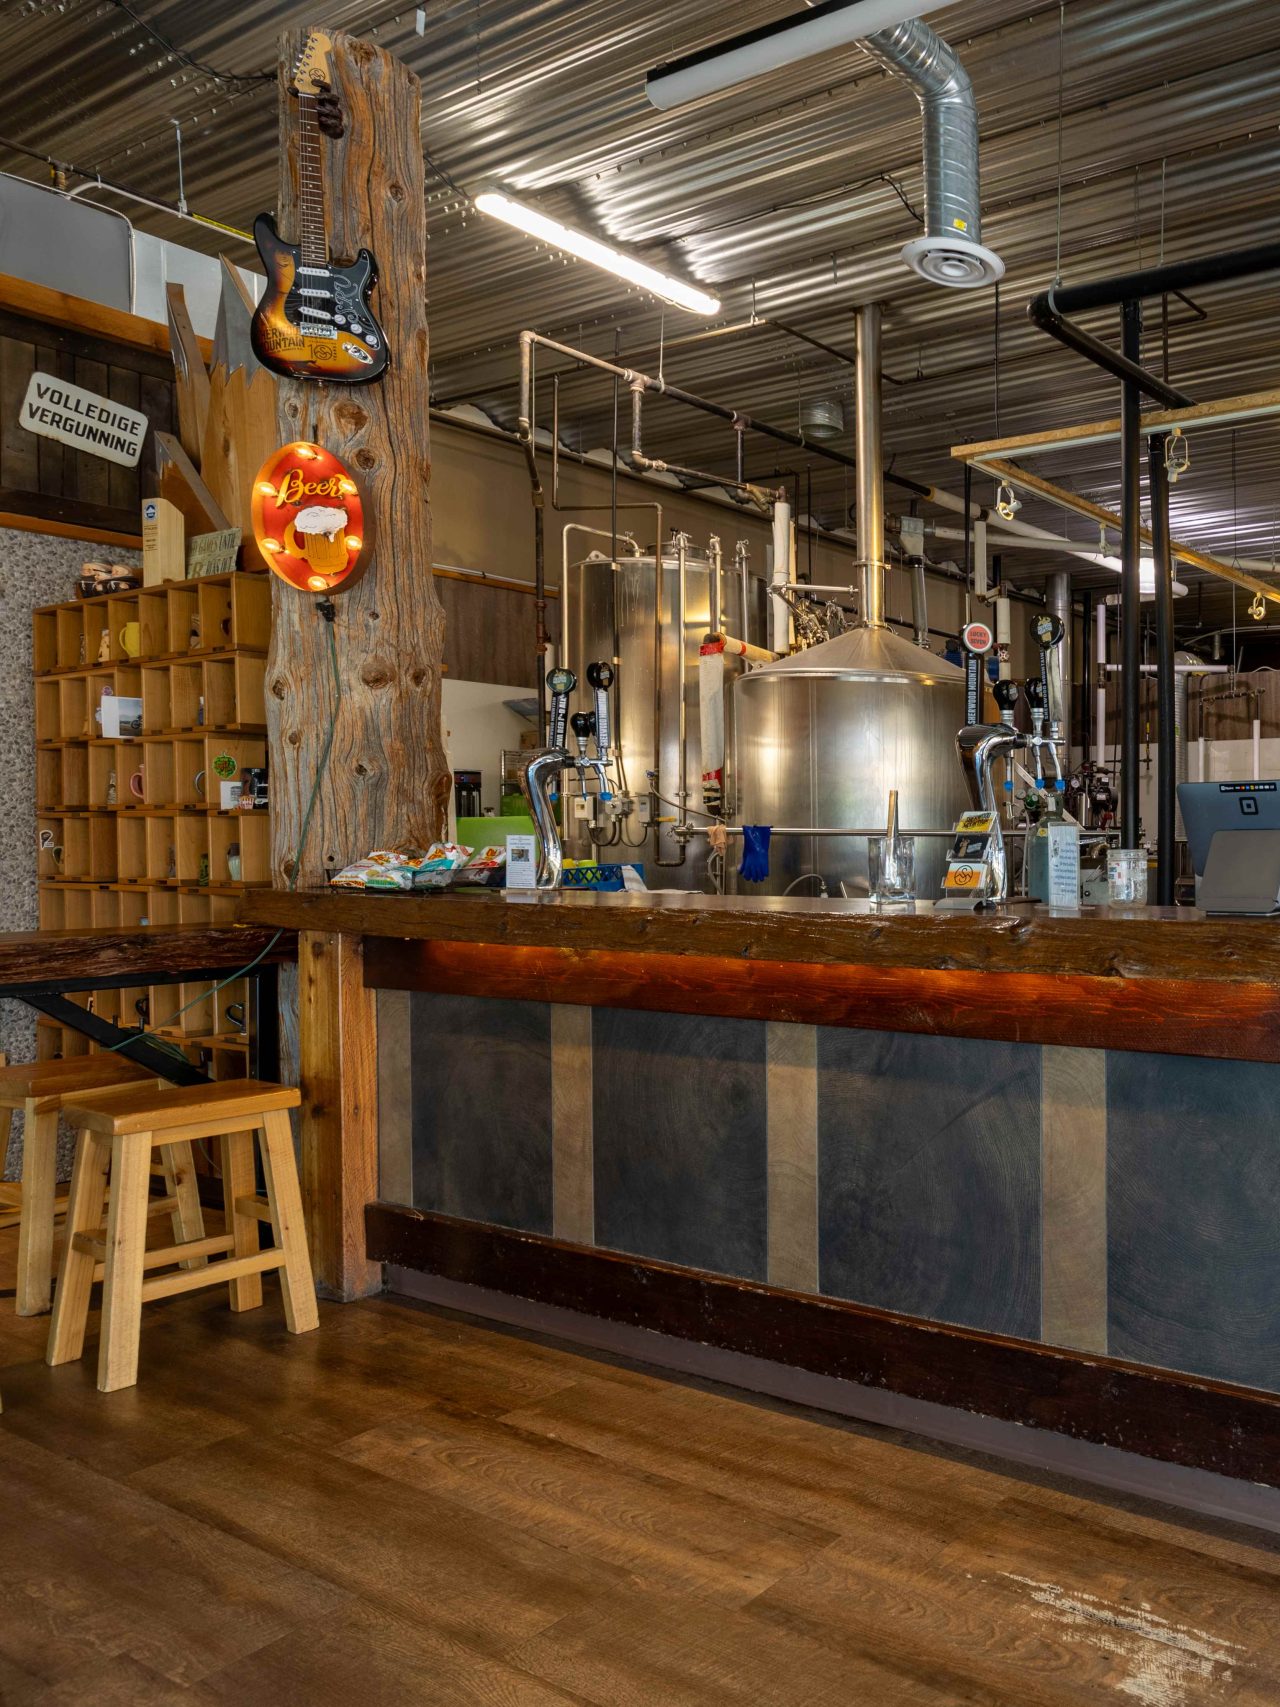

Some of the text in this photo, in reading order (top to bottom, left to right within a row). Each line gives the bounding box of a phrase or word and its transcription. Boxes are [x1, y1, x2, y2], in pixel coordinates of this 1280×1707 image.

[28, 402, 138, 458] VERGUNNING
[36, 382, 141, 437] VOLLEDIGE
[275, 469, 347, 507] Beer
[967, 659, 977, 725] SHERWOOD MOUNTAIN
